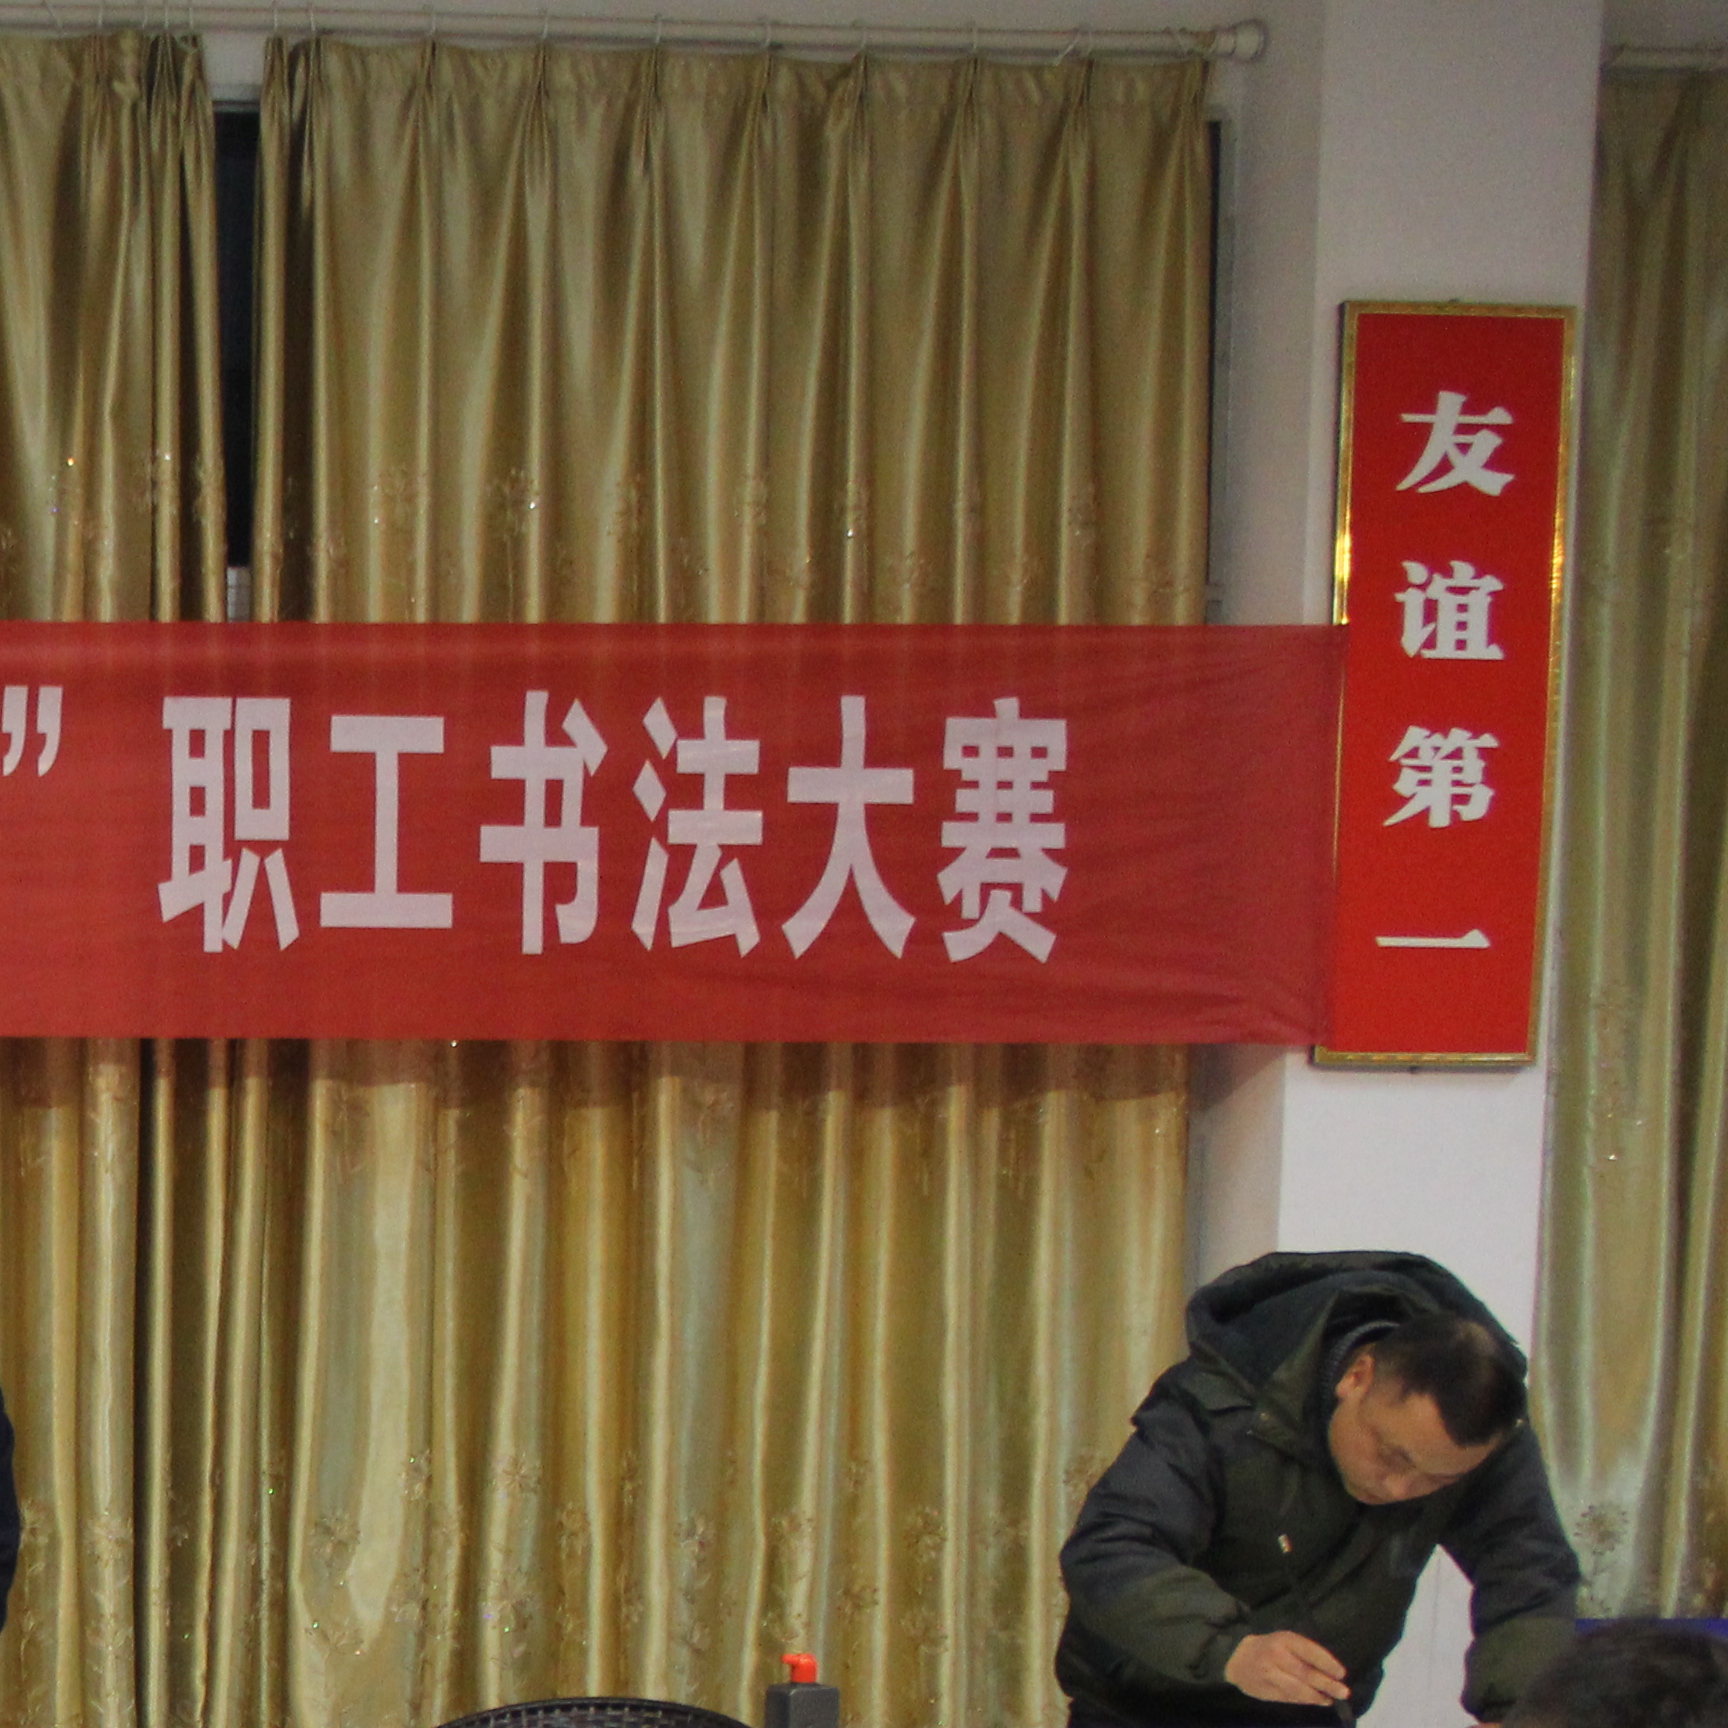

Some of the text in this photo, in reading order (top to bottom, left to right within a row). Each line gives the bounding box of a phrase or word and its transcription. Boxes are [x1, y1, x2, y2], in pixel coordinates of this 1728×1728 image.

[156, 688, 1069, 964] 职工书法大赛
[1374, 389, 1516, 951] 友谊第一
